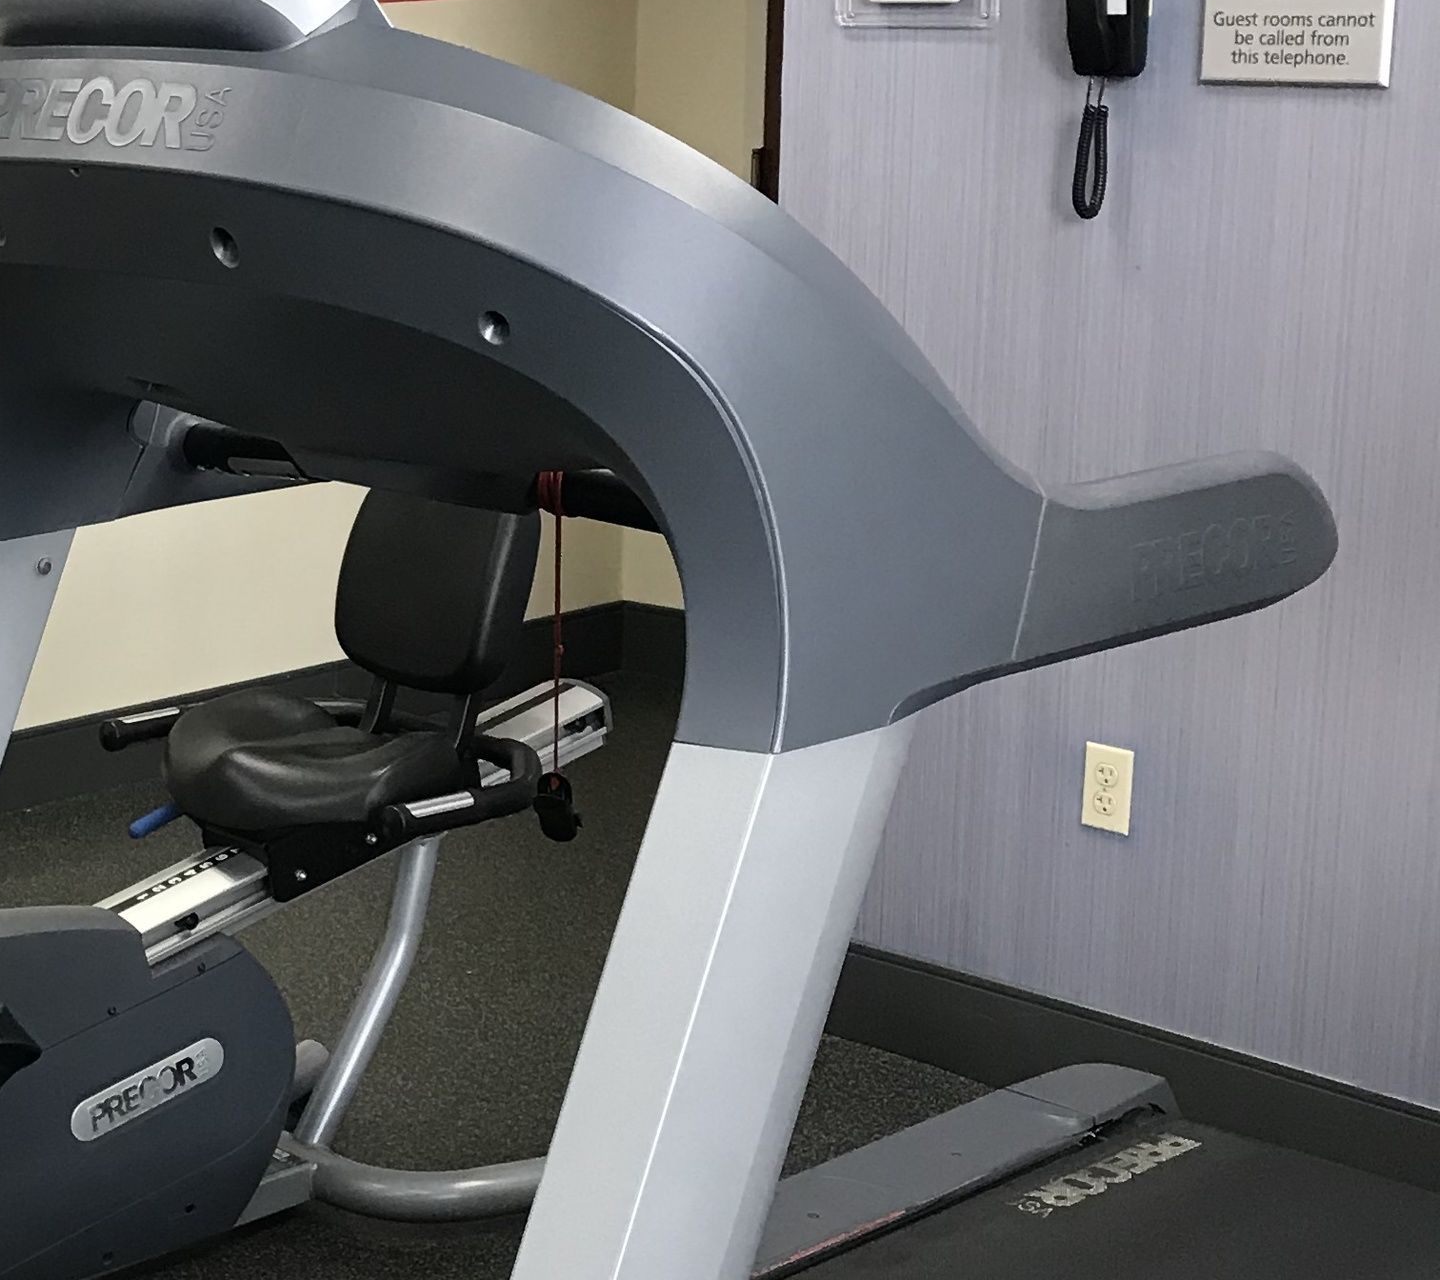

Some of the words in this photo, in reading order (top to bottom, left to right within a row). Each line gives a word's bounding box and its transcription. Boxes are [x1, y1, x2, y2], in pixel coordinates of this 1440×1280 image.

[1213, 10, 1259, 27] Guest
[1263, 14, 1313, 28] rooms
[1317, 12, 1376, 28] cannot
[1234, 29, 1254, 46] be
[1259, 30, 1305, 46] called
[1310, 29, 1350, 47] from
[1231, 48, 1259, 65] this
[1264, 50, 1350, 68] telephone.
[184, 86, 233, 152] USA
[88, 1056, 198, 1133] PRECOR
